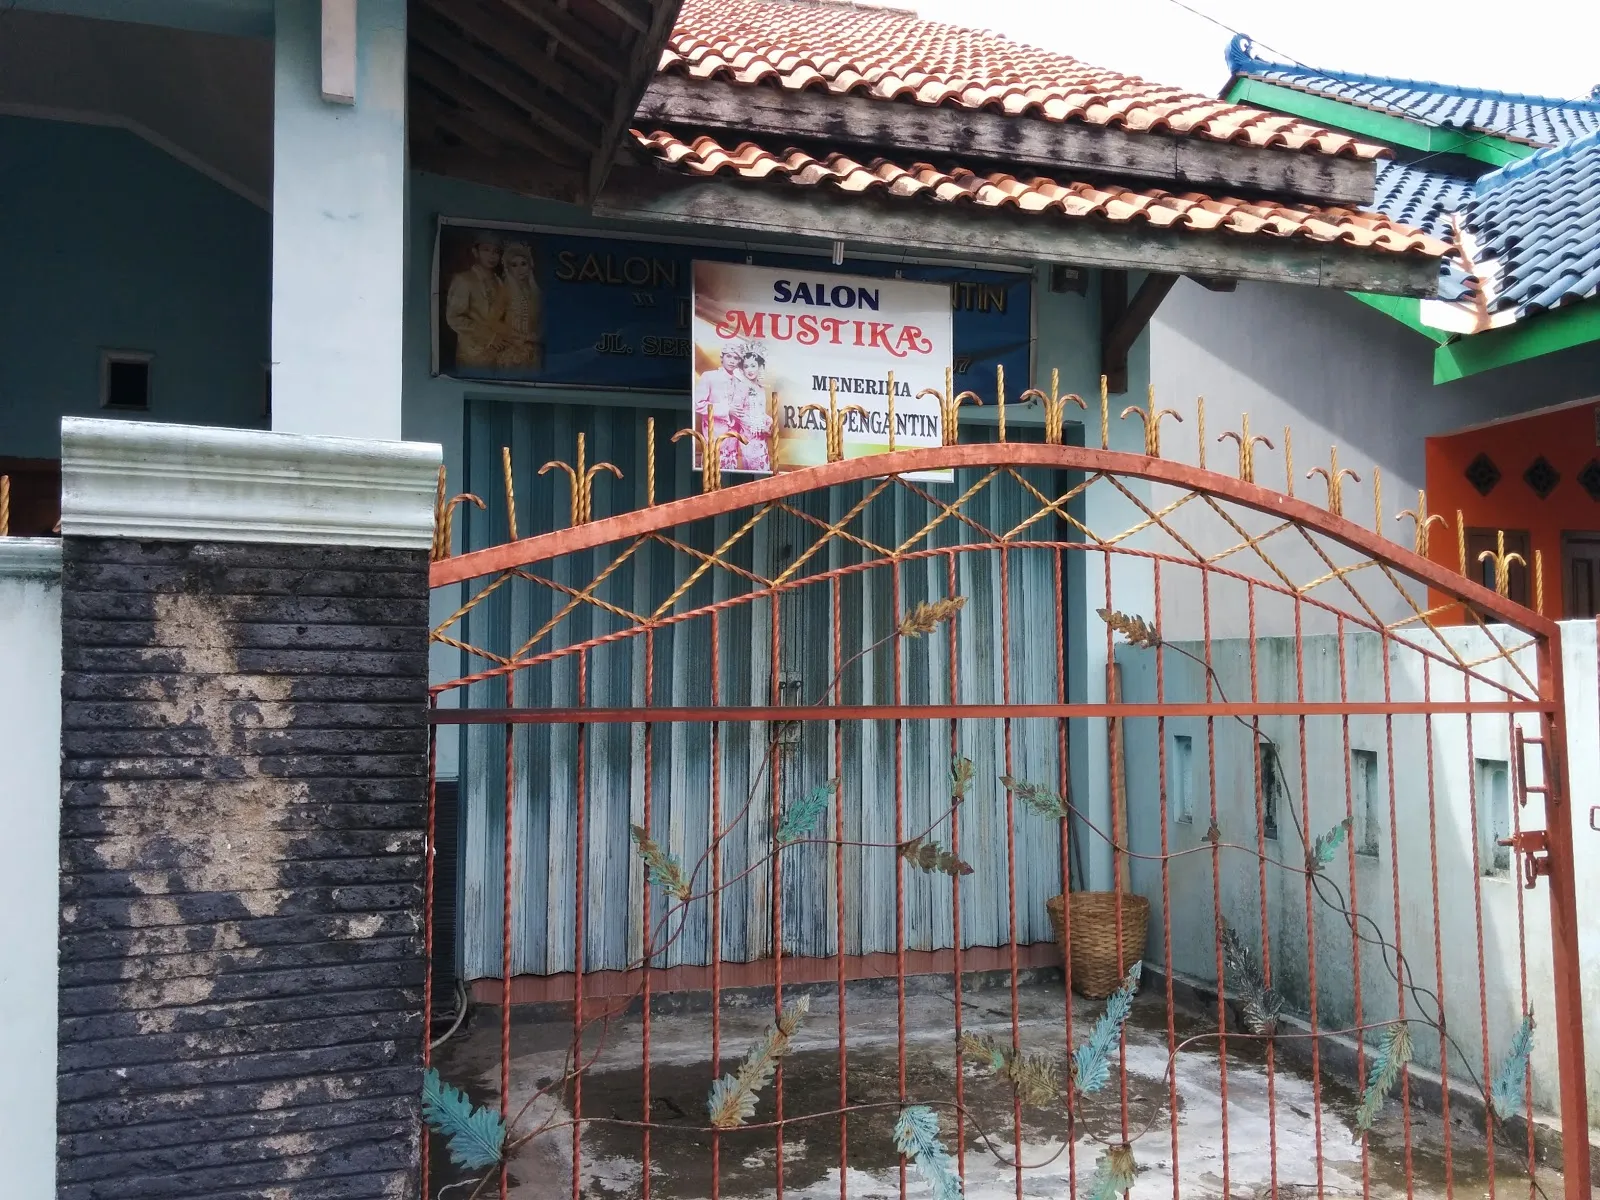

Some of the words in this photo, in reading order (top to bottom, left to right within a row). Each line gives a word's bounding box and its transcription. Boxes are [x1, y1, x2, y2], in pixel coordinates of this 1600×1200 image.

[555, 249, 677, 287] SALON
[774, 279, 879, 311] SALON
[595, 332, 633, 354] JL.
[715, 310, 933, 358] MUSTIKA
[812, 375, 912, 398] MENERIMA
[783, 404, 829, 432] RIAS
